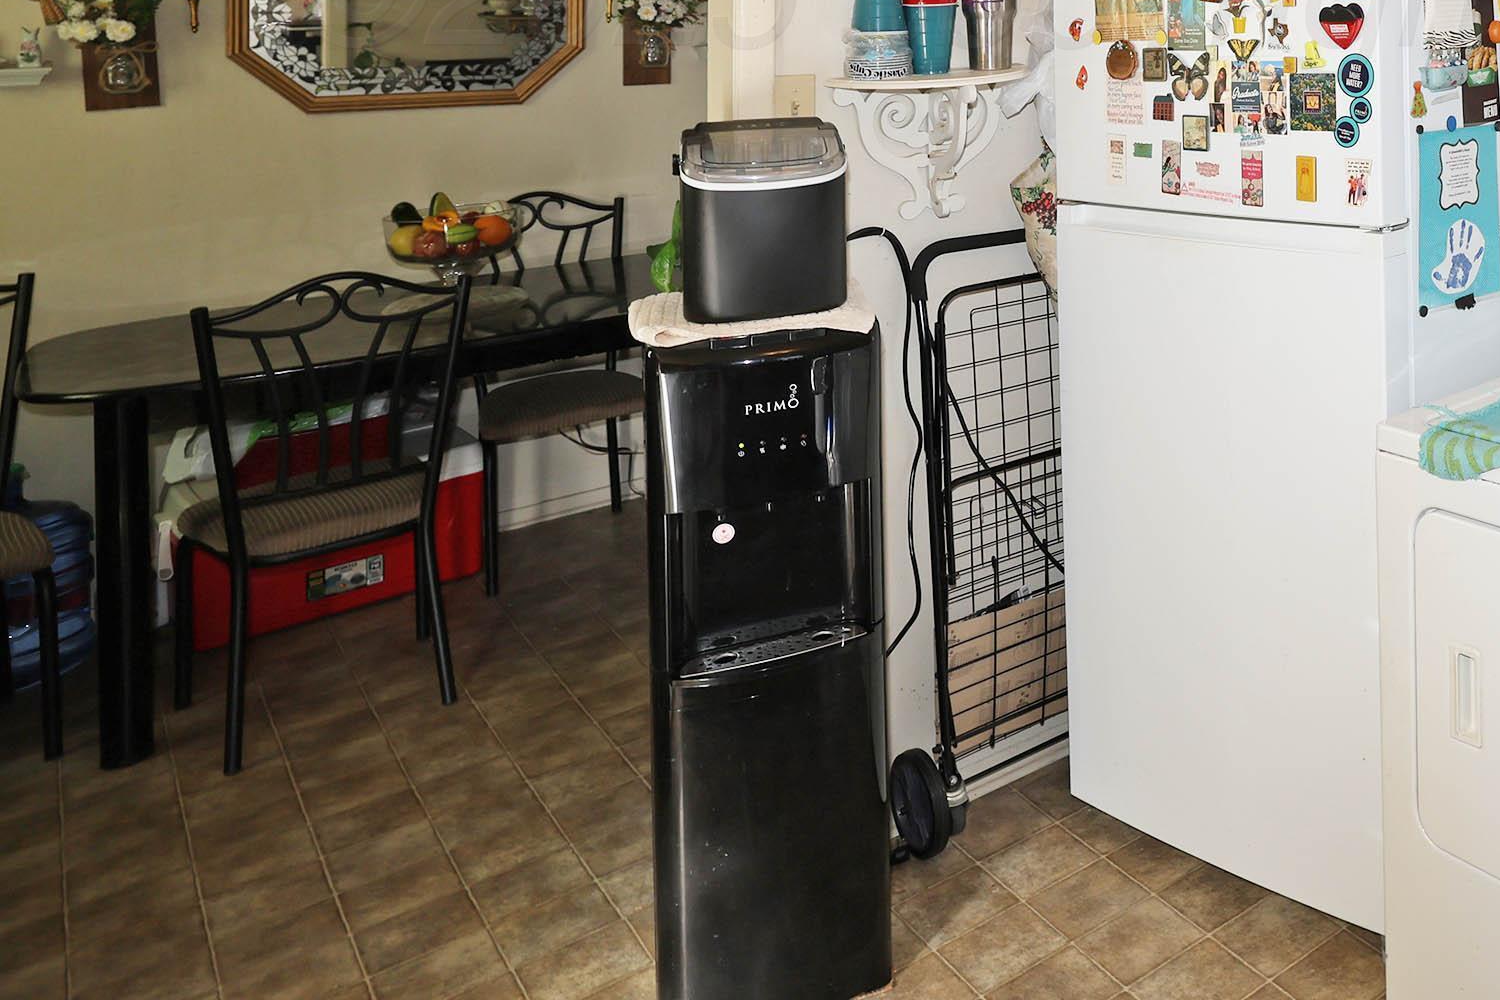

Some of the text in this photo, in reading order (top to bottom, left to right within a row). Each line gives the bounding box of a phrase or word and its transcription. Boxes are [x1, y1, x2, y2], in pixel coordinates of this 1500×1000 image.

[849, 63, 907, 80] Plastic Cups
[1350, 63, 1362, 72] NEED
[1349, 71, 1360, 80] MORE
[1346, 78, 1363, 88] WATER?
[1232, 86, 1260, 100] Graduate
[745, 390, 799, 415] PRIMO
